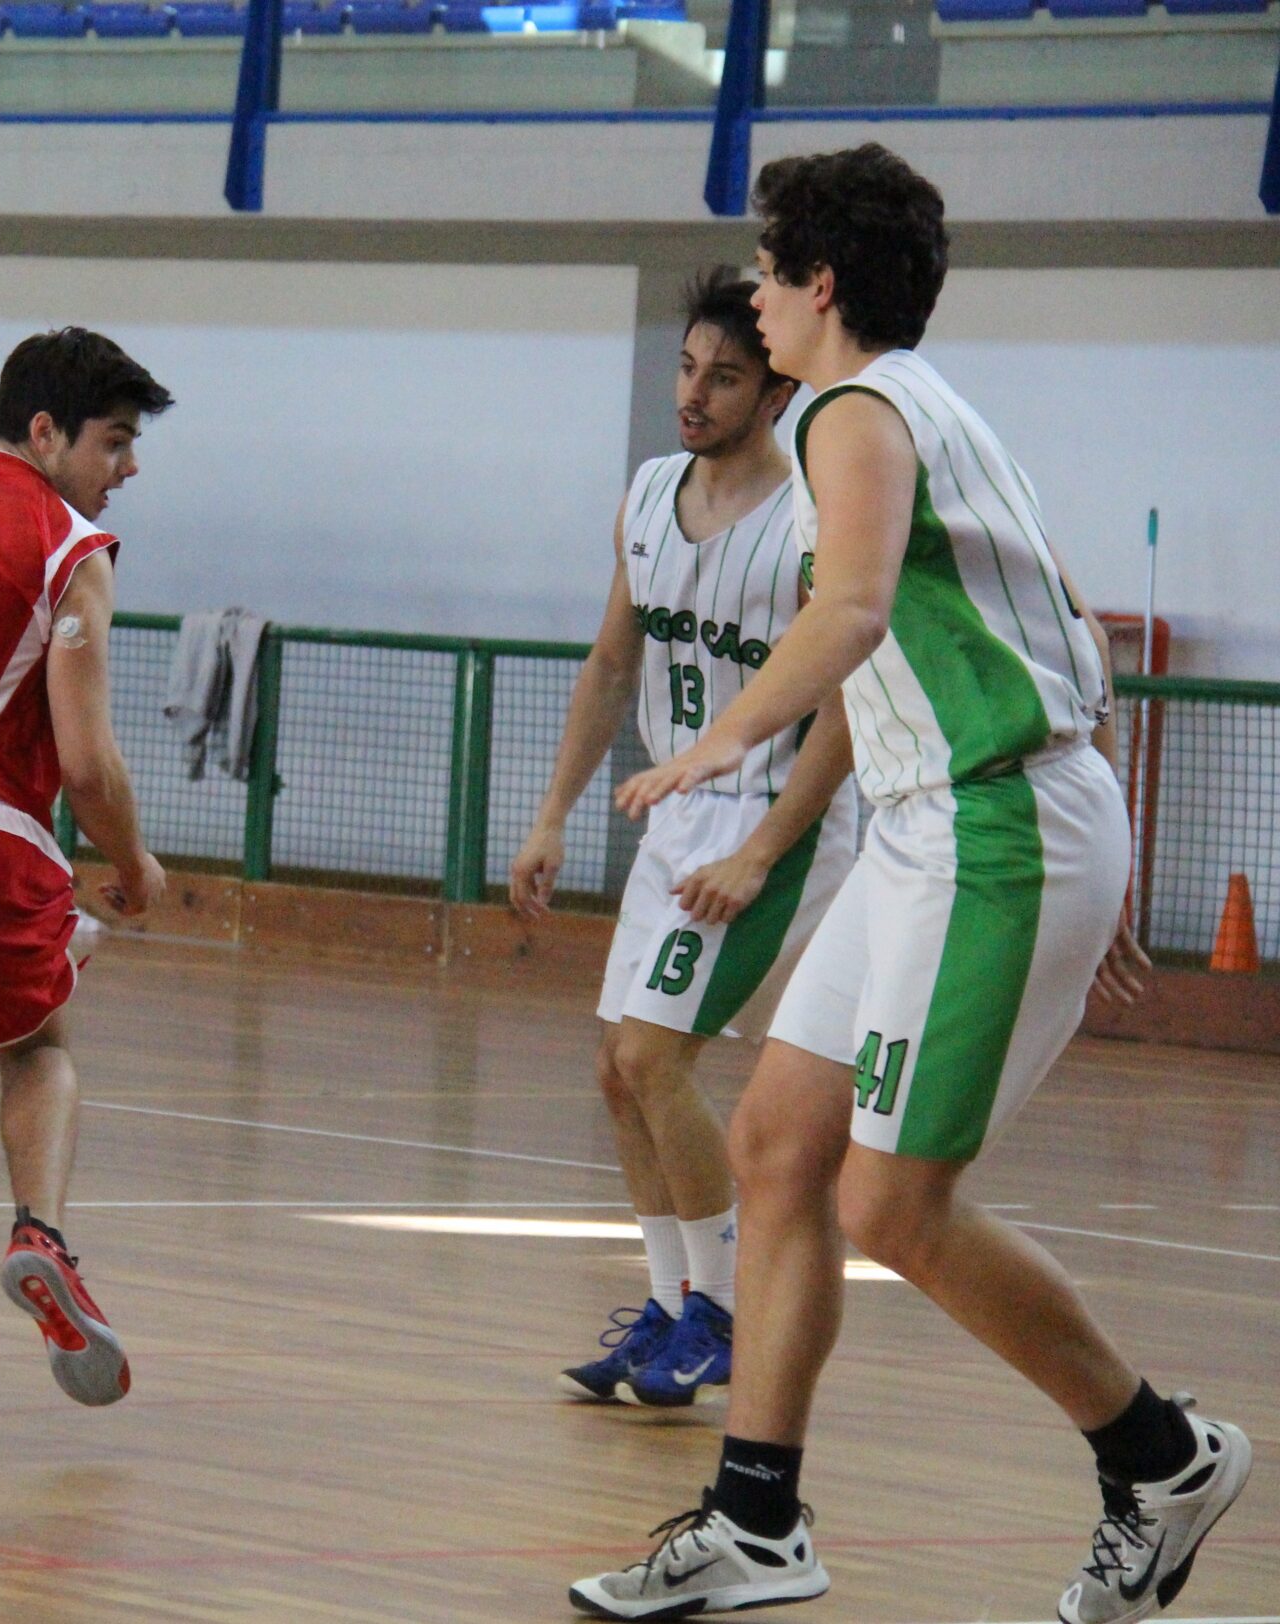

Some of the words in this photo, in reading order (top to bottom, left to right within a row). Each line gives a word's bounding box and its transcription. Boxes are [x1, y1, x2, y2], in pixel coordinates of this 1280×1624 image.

[668, 663, 705, 730] 13
[646, 928, 703, 996] 13
[854, 1030, 909, 1116] 41
